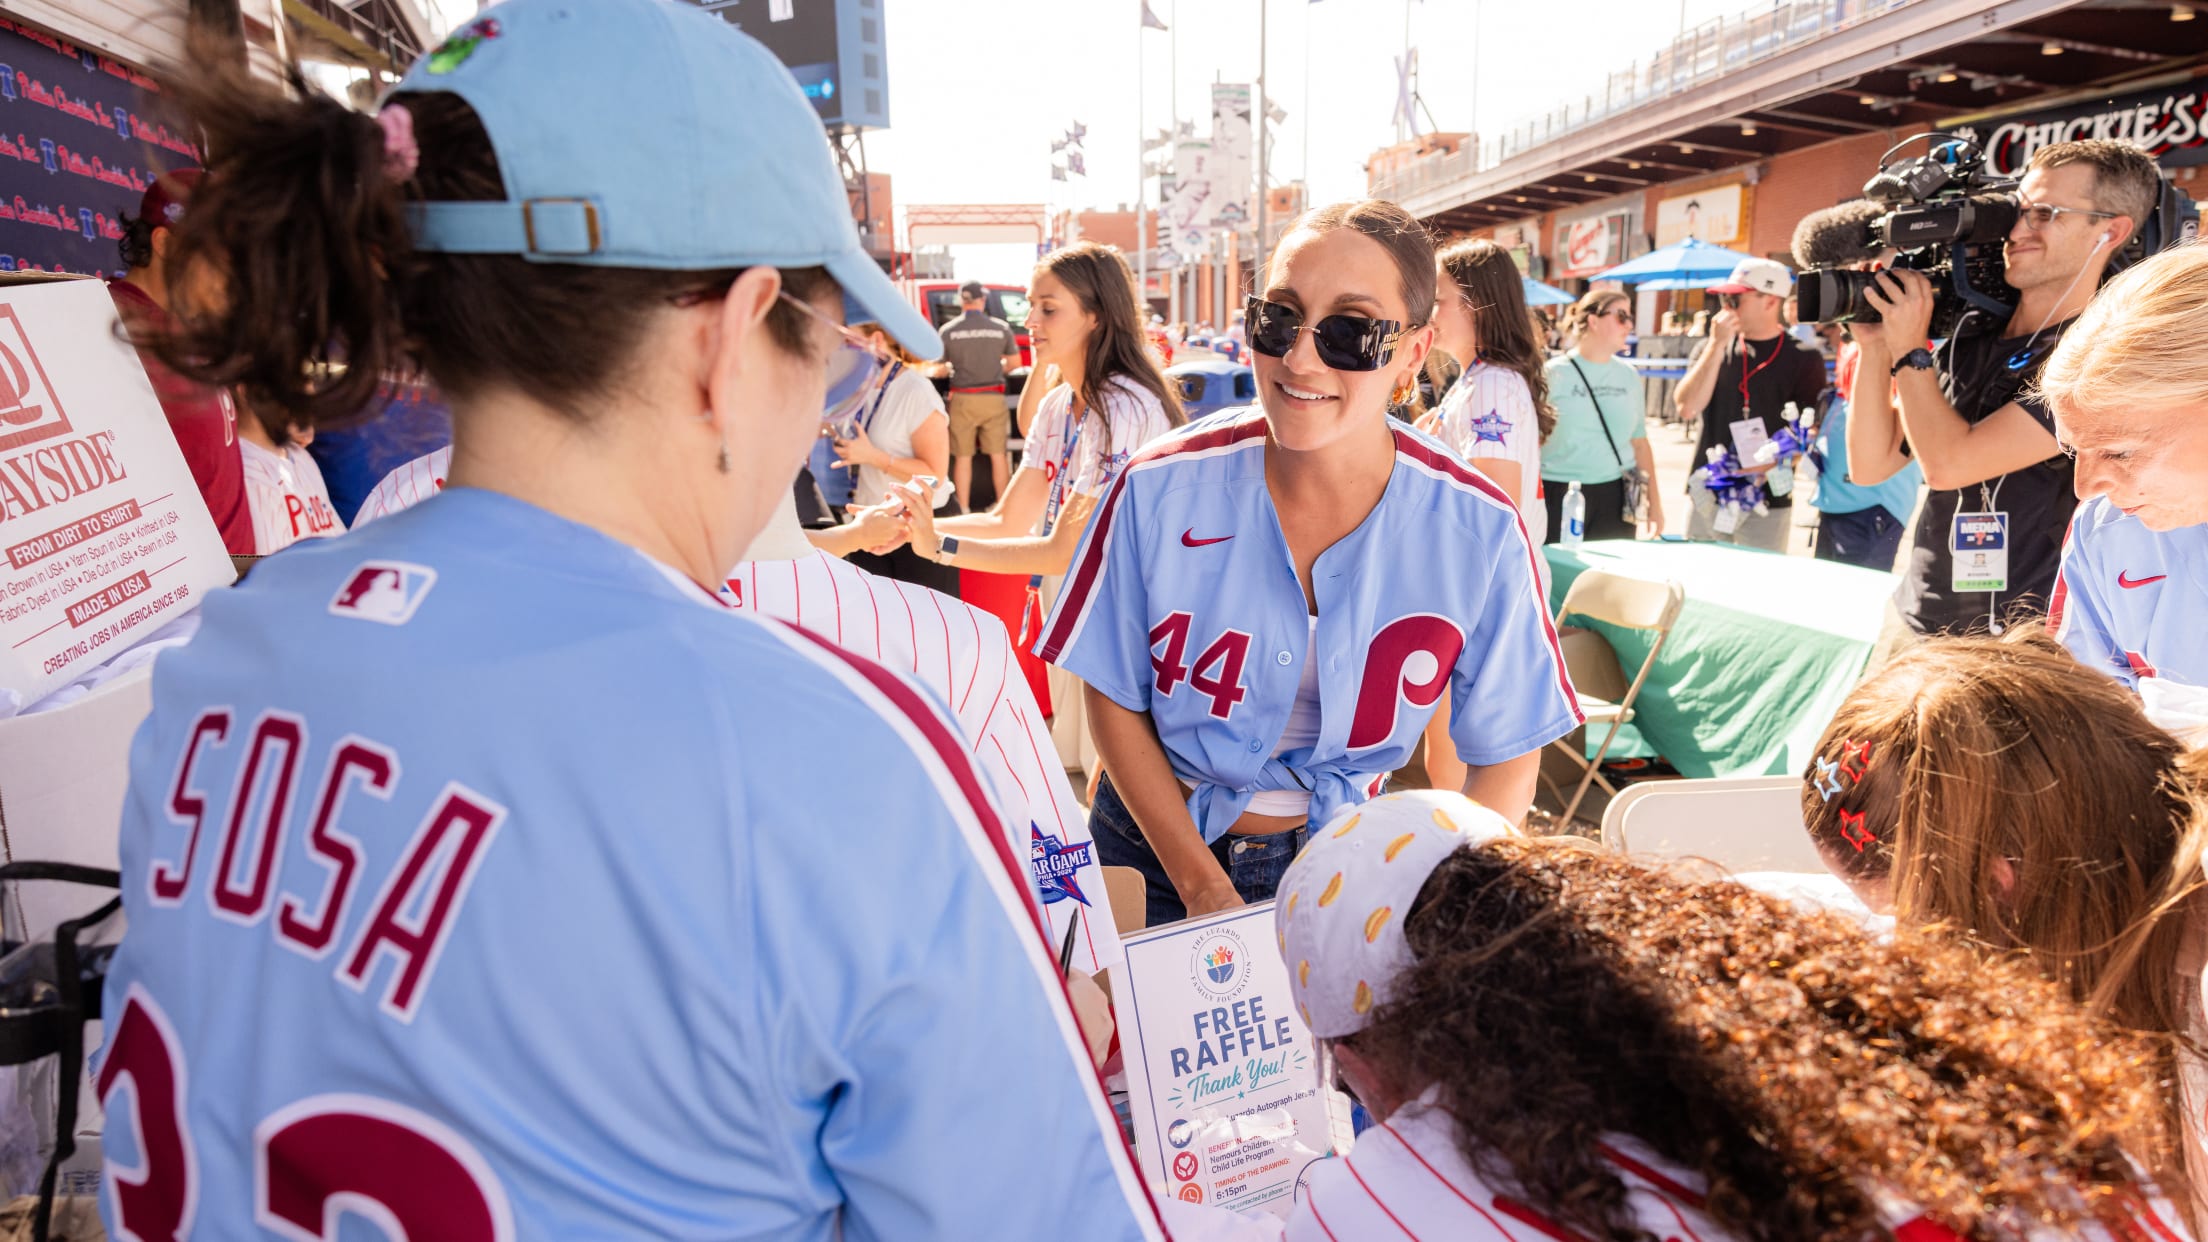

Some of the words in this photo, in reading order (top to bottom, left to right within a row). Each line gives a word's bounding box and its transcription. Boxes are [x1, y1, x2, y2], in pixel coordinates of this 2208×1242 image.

[1985, 93, 2197, 178] CHICKIE'S
[0, 431, 127, 523] AYSIDE
[7, 576, 38, 596] Grown
[35, 571, 47, 583] in
[45, 561, 66, 579] USA
[69, 552, 90, 567] Yarn
[87, 543, 109, 561] Spun
[106, 539, 116, 552] in
[116, 532, 132, 548] USA
[135, 521, 160, 538] Knitted
[164, 510, 180, 525] USA
[12, 535, 55, 566] FROM
[52, 524, 83, 548] DIRT
[82, 517, 101, 536] TO
[101, 503, 134, 529] SHIRT
[1959, 522, 2001, 534] MEDIA
[0, 602, 29, 624] Fabric
[26, 590, 51, 611] Dyed
[49, 587, 59, 600] in
[57, 577, 79, 595] USA
[82, 568, 98, 584] Die
[96, 561, 112, 577] Cut
[110, 558, 119, 571] in
[117, 550, 135, 567] USA
[137, 541, 158, 557] Sewn
[162, 530, 178, 545] USA
[71, 592, 109, 625] MADE
[107, 586, 122, 606] IN
[121, 575, 146, 599] USA
[43, 639, 89, 675] CREATING
[89, 628, 111, 650] JOBS
[110, 622, 121, 638] IN
[119, 604, 154, 632] AMERICA
[152, 592, 175, 614] SINCE
[1149, 609, 1254, 722] 44
[1346, 611, 1467, 751] P
[148, 706, 507, 1025] SOSA
[1032, 859, 1052, 875] AR
[1050, 848, 1088, 872] GAME
[1192, 934, 1206, 950] THE
[1206, 927, 1241, 941] LUZARDO
[1190, 975, 1214, 1002] FAMILY
[1216, 961, 1252, 1003] FOUNDATION
[1193, 995, 1266, 1040] FREE
[1170, 1016, 1293, 1078] RAFFLE
[1187, 1065, 1244, 1103] Thank
[1246, 1050, 1287, 1089] You!
[1226, 1107, 1255, 1123] uzrdo
[1256, 1095, 1293, 1113] Autograph
[1293, 1088, 1317, 1101] Jerey
[1210, 1148, 1242, 1165] Nemours
[1242, 1137, 1275, 1153] Children
[1211, 1162, 1231, 1174] Child
[1231, 1157, 1245, 1168] Life
[1245, 1147, 1275, 1162] Program
[1214, 1177, 1238, 1189] TIMING
[1237, 1172, 1247, 1182] OF
[1248, 1168, 1260, 1178] THE
[1259, 1157, 1291, 1174] DRAWING:
[1216, 1183, 1248, 1200] 6:15pm
[1236, 1195, 1261, 1209] contacted
[1261, 1191, 1269, 1200] by
[1268, 1187, 1284, 1198] phone
